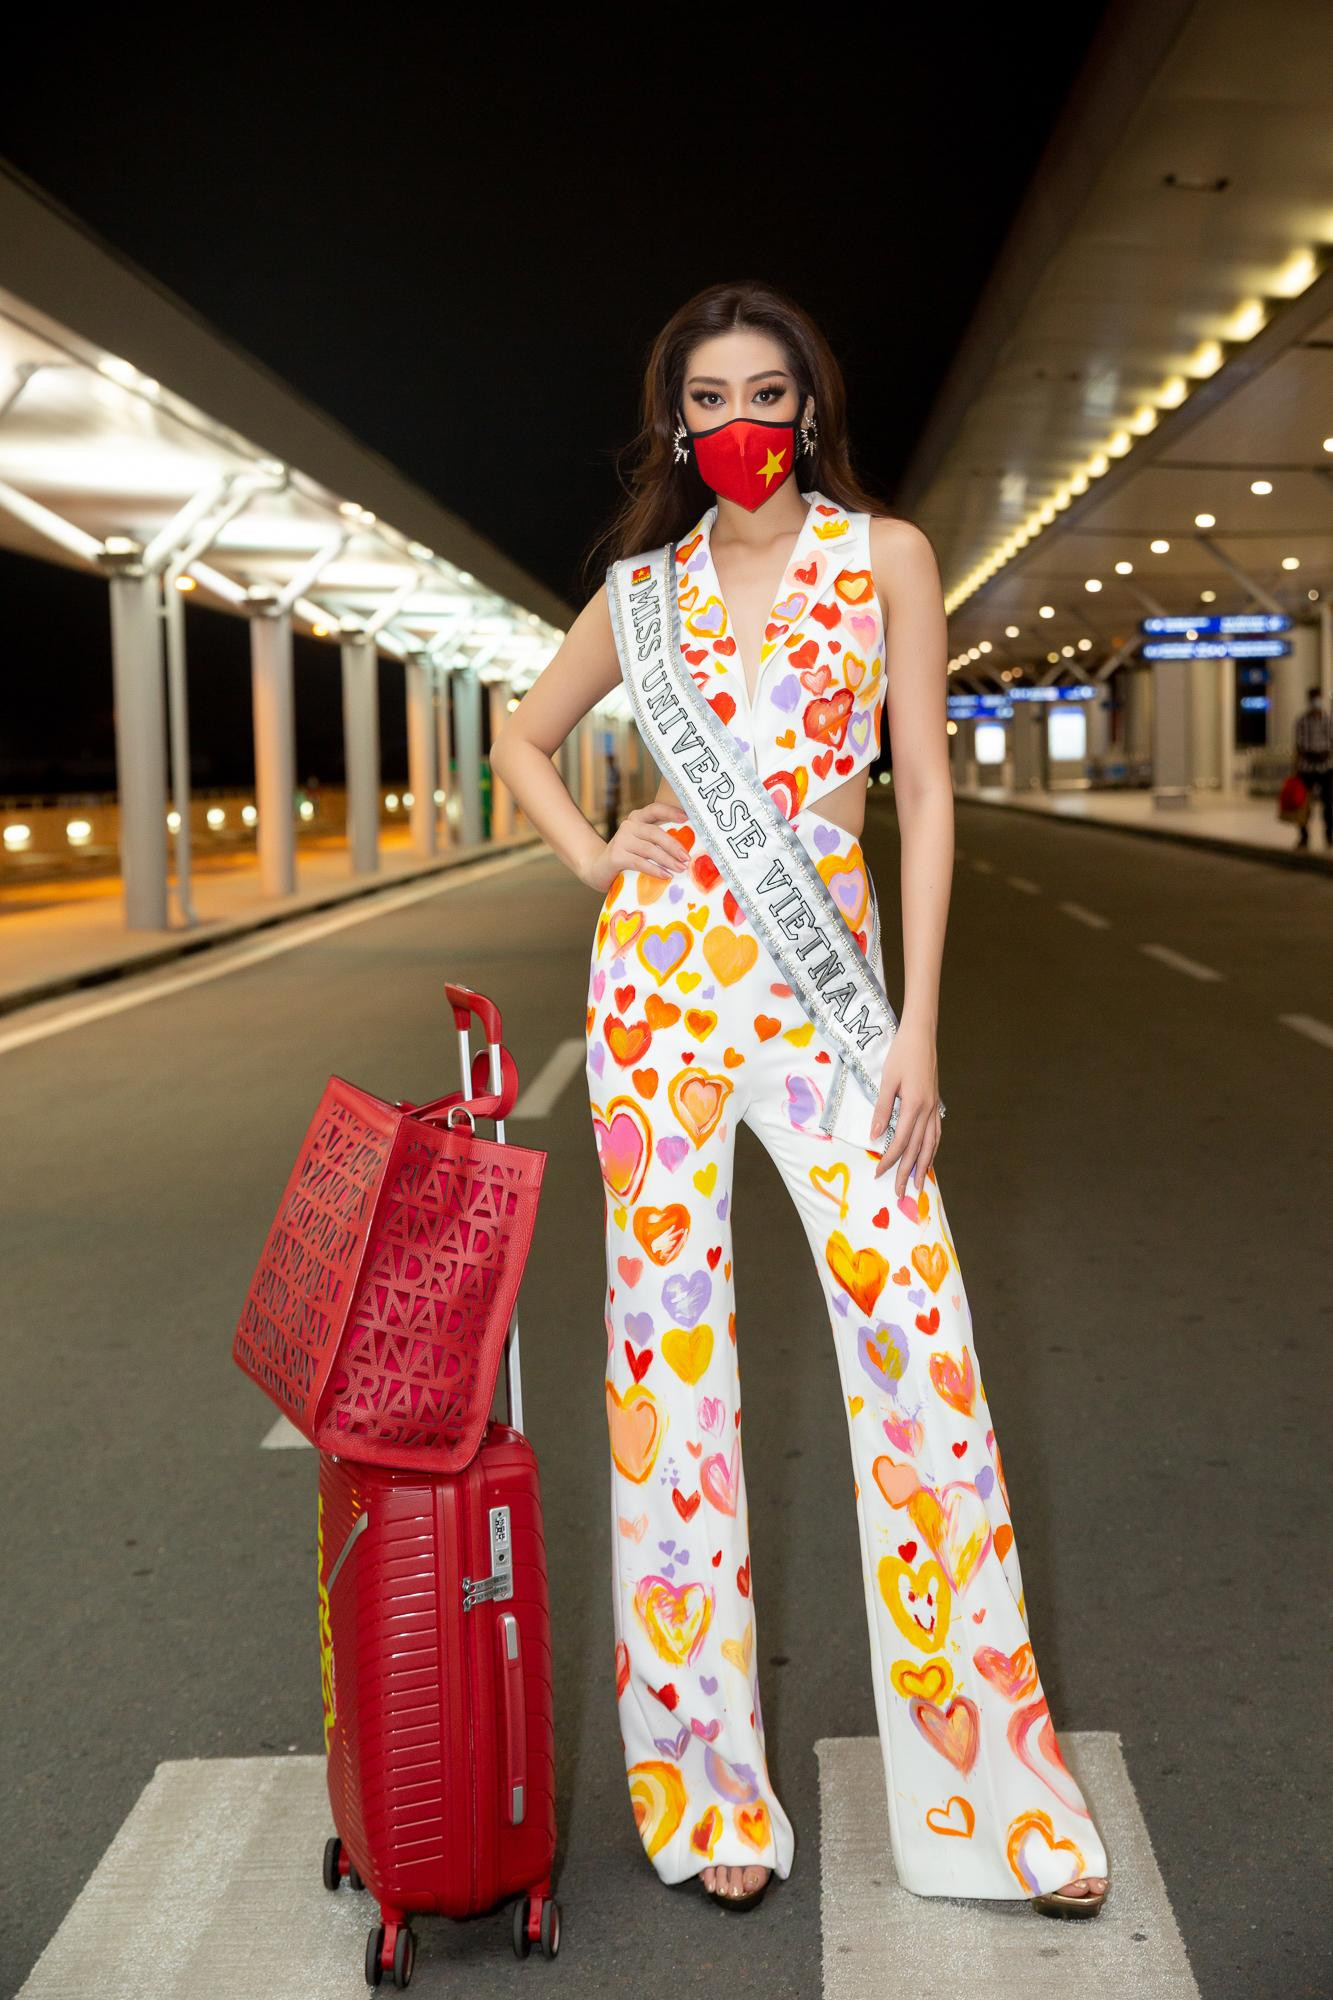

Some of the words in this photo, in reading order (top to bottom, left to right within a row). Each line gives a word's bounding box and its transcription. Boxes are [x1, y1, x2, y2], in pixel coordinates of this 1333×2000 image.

[629, 579, 662, 662] MISS
[642, 658, 767, 861] UNIVERSE
[757, 859, 882, 1052] VIETNAM
